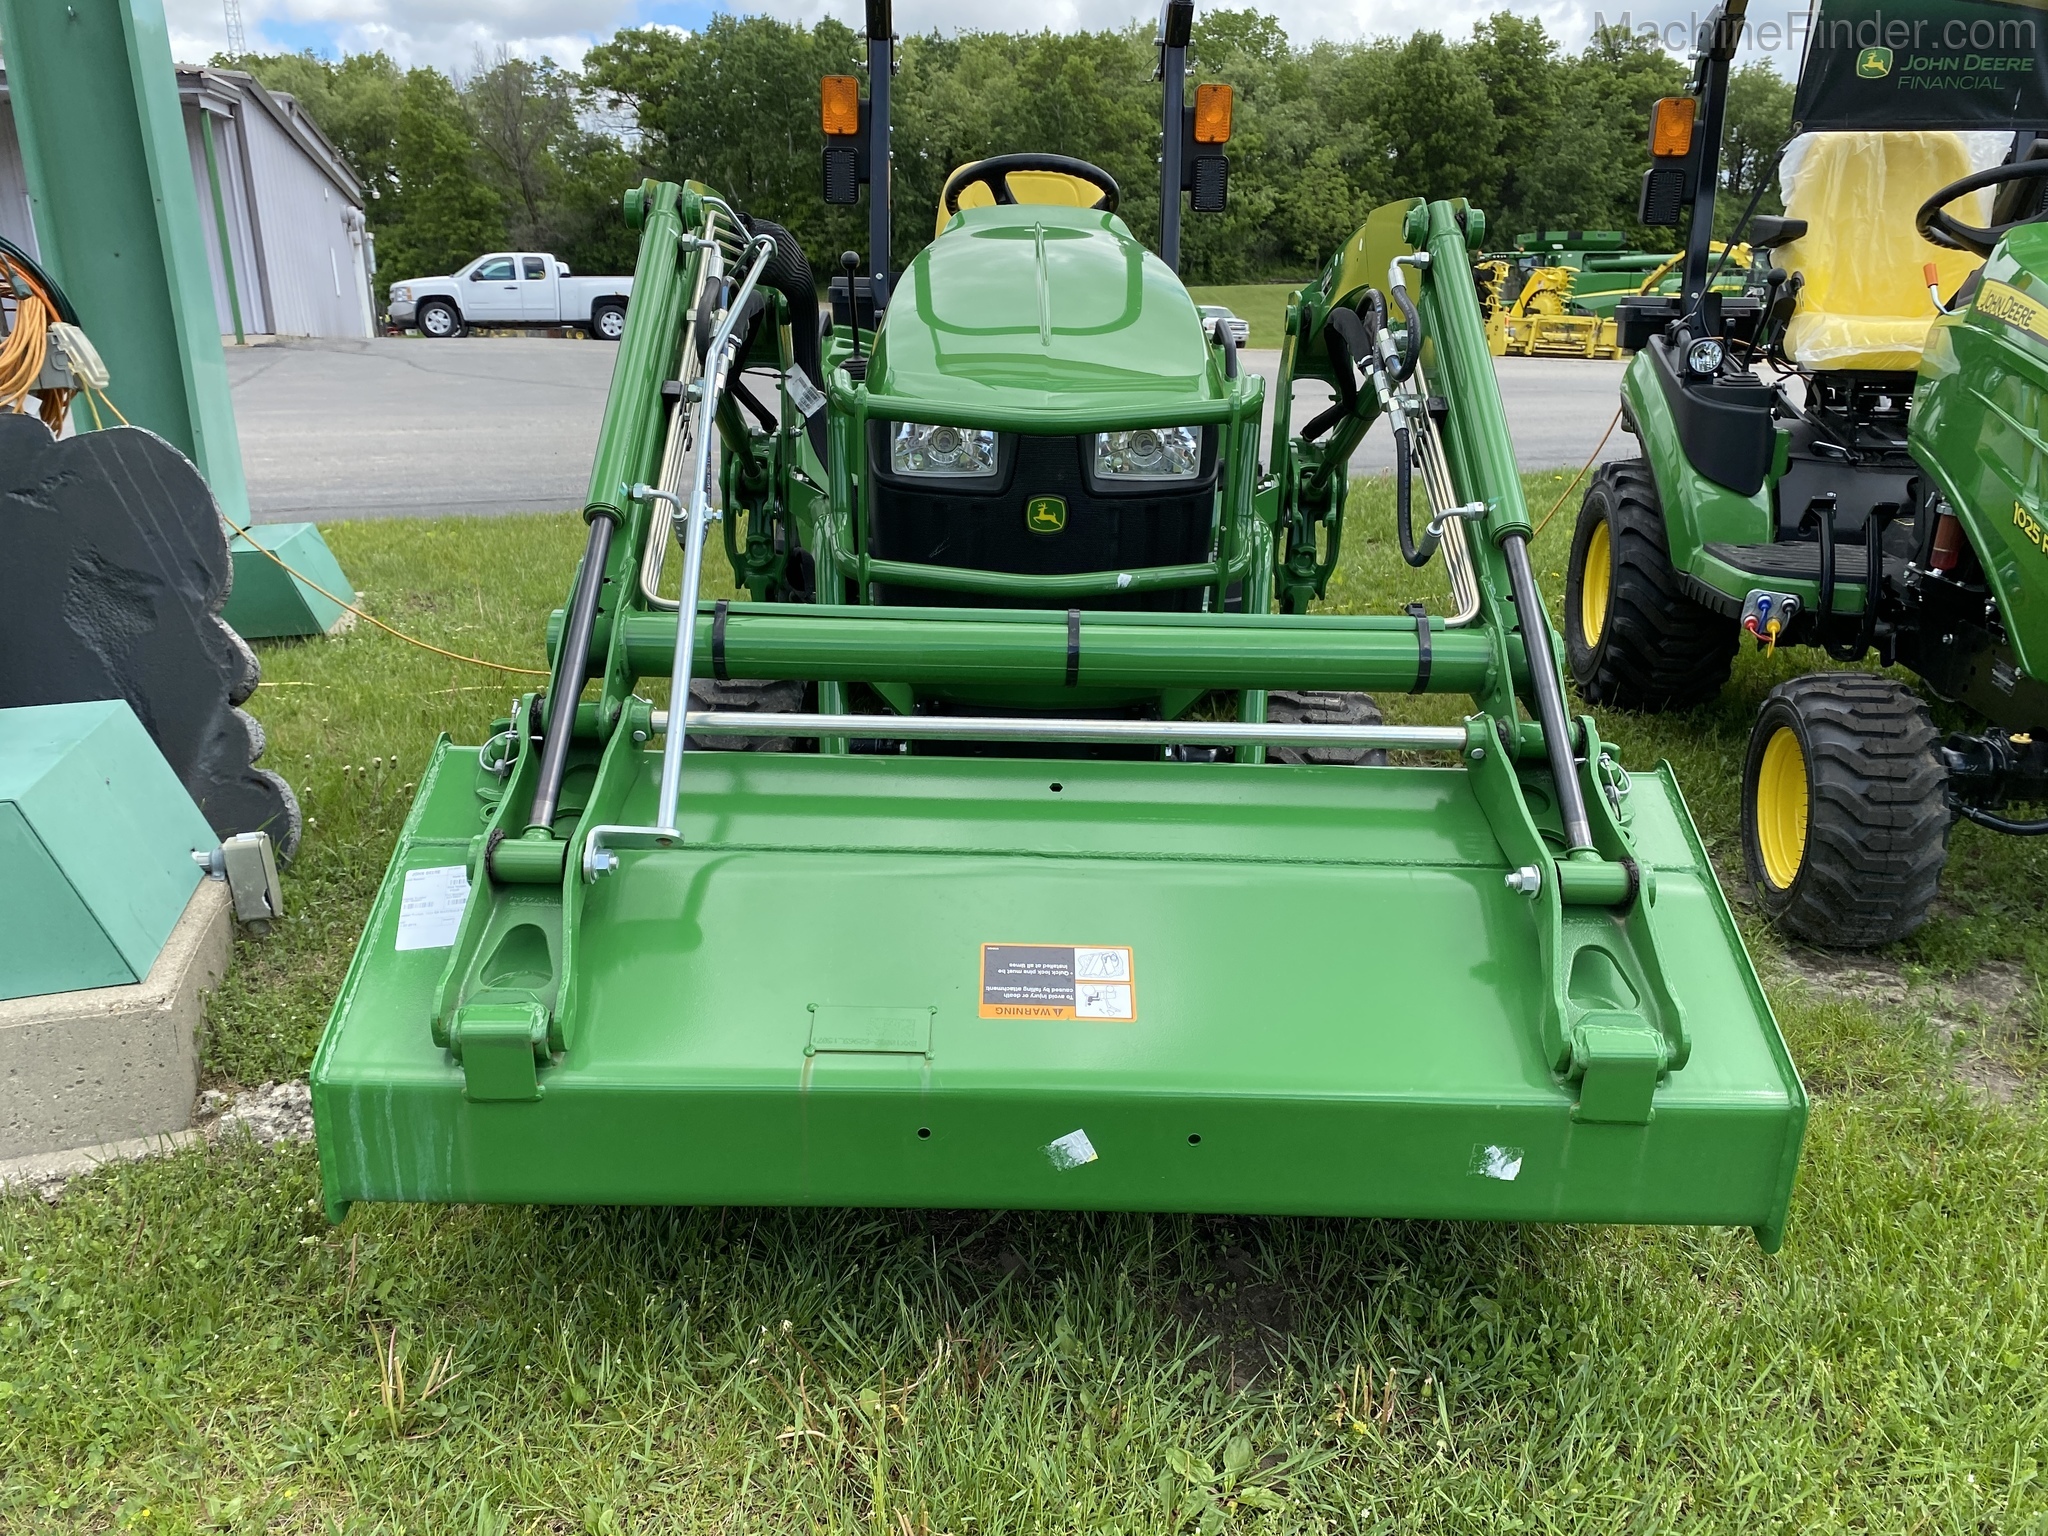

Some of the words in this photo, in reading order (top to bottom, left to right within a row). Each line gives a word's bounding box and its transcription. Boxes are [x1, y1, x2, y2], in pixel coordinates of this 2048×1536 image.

[1900, 54, 1960, 71] JOHN
[1963, 54, 2035, 72] DEERE
[1897, 76, 2006, 90] FINANCIAL
[1979, 290, 2006, 315] JOHN
[2001, 296, 2037, 327] DEERE
[2013, 501, 2041, 544] 1025
[995, 1006, 1051, 1016] WARNING
